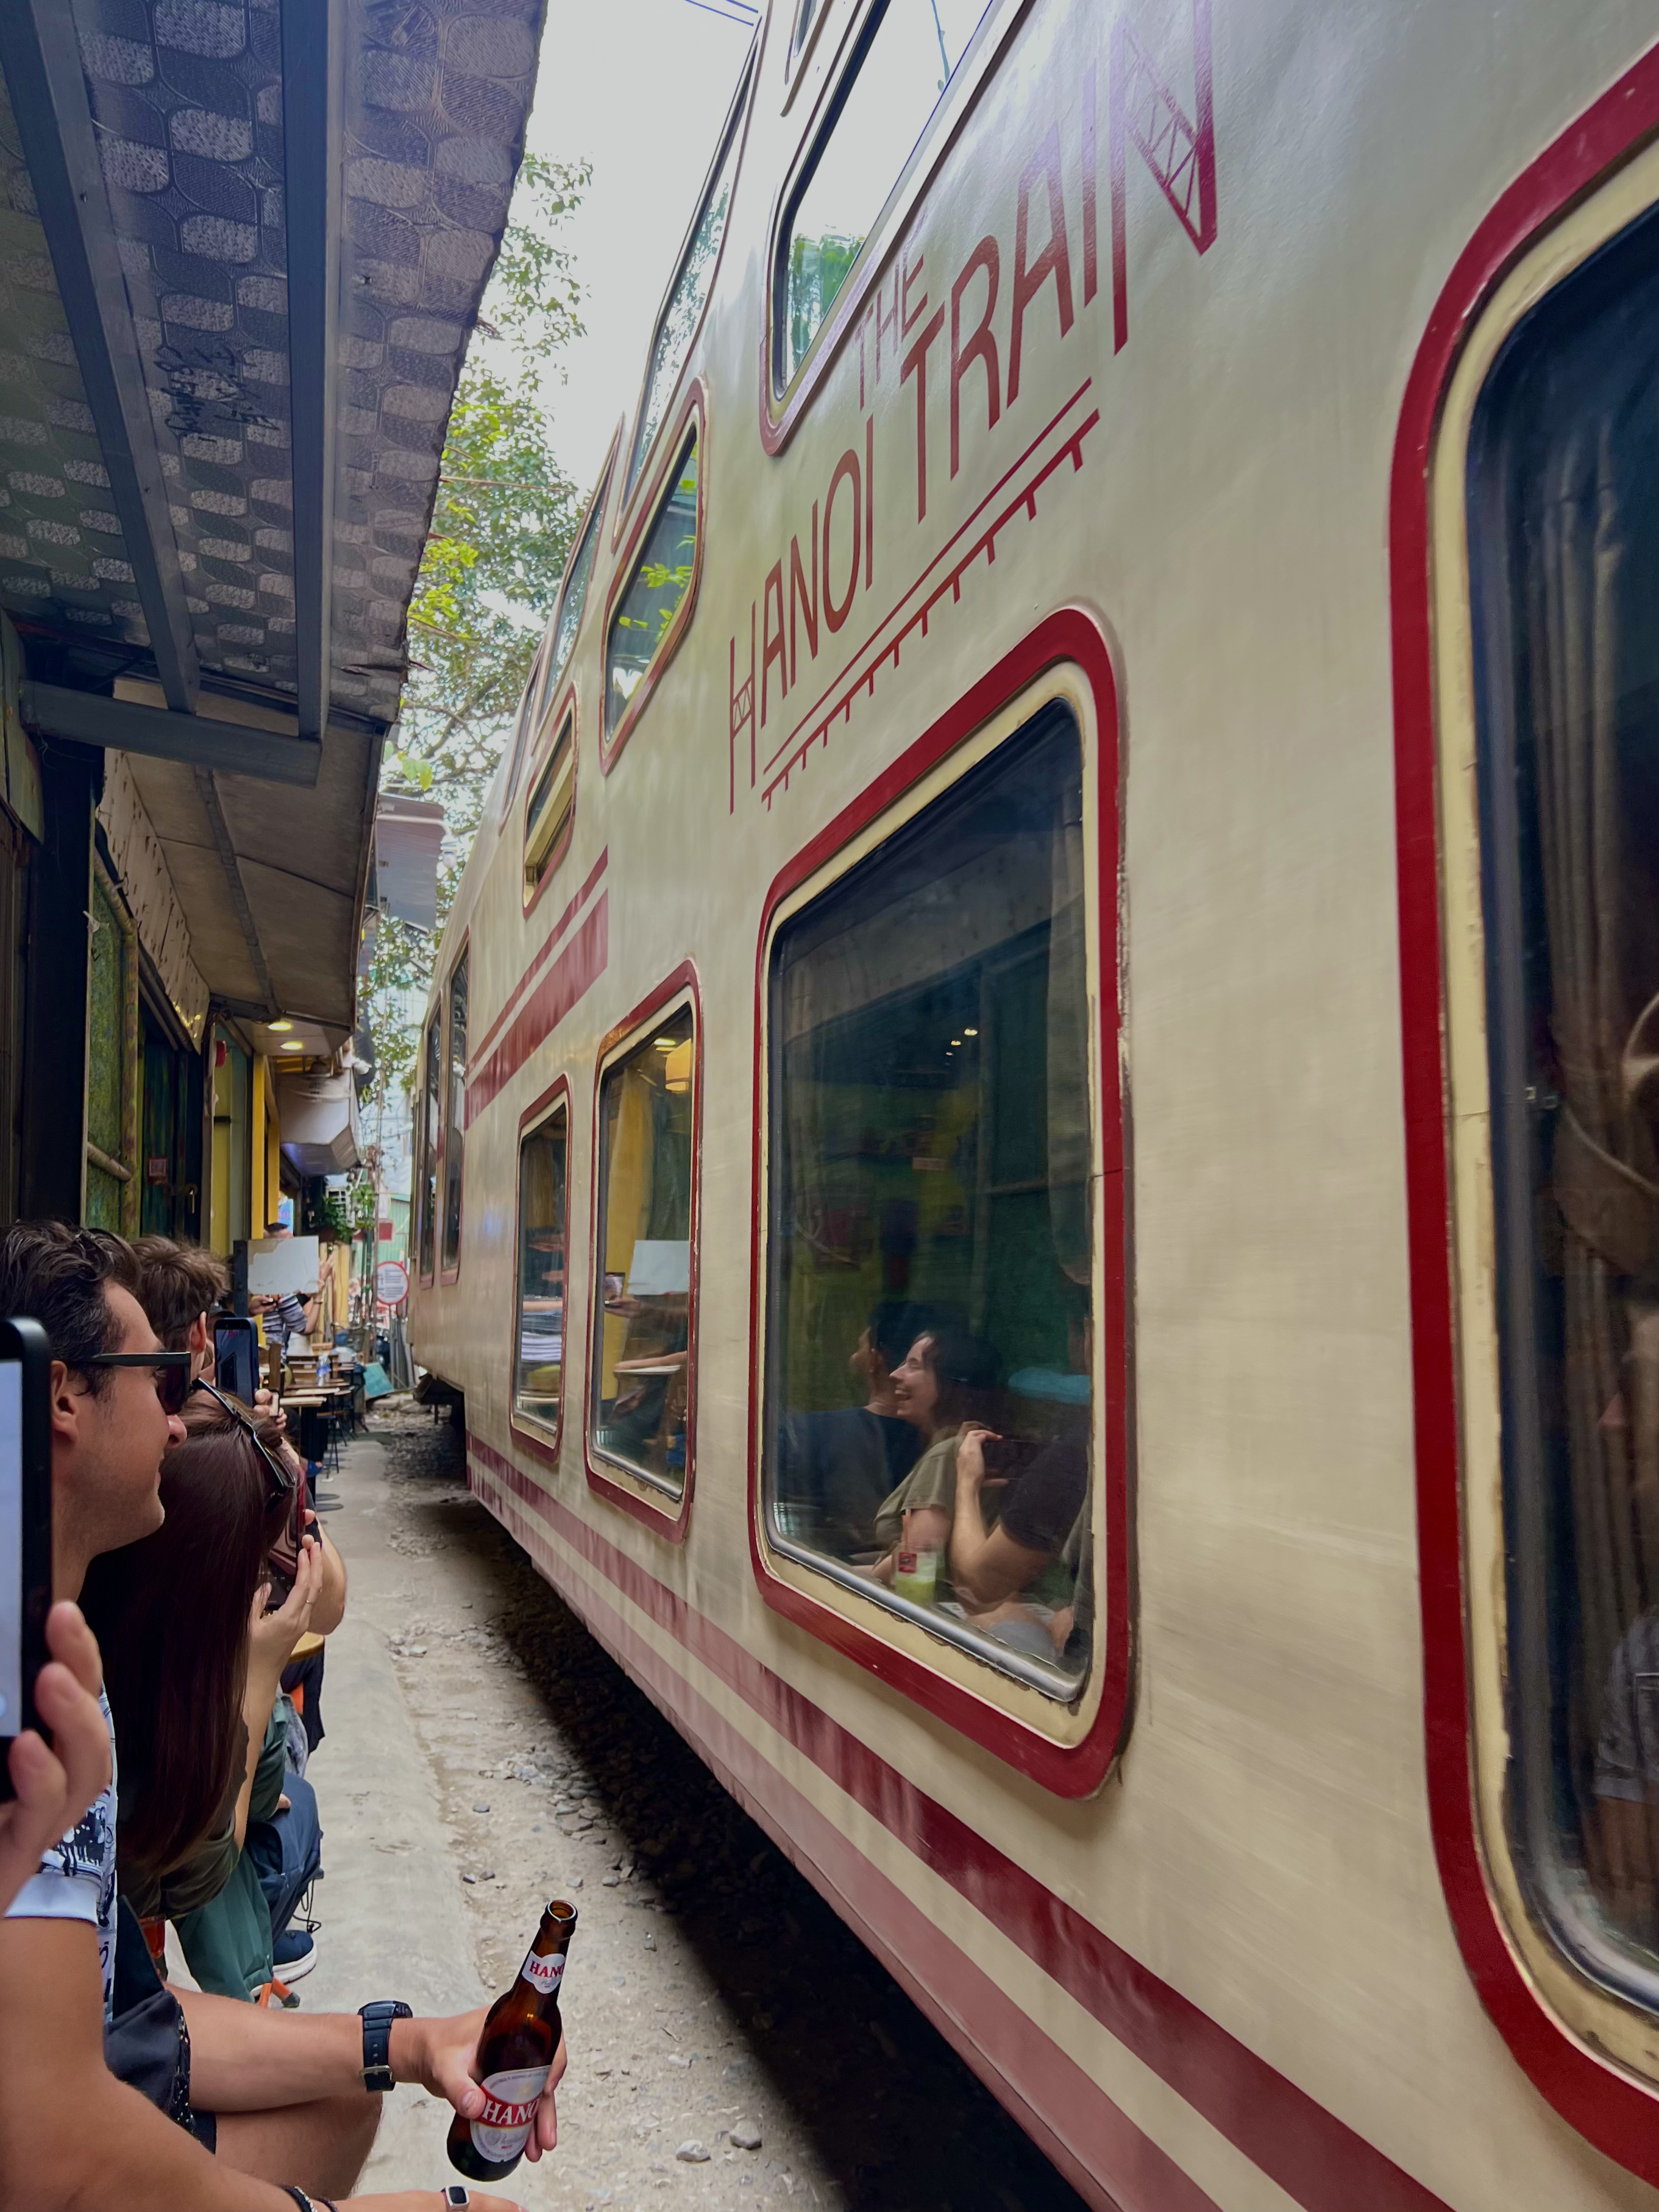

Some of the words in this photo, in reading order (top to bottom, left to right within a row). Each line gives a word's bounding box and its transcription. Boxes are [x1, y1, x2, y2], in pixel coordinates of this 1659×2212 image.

[730, 414, 873, 816] HANOI
[900, 0, 1218, 524] TRAIN
[854, 207, 928, 413] THE
